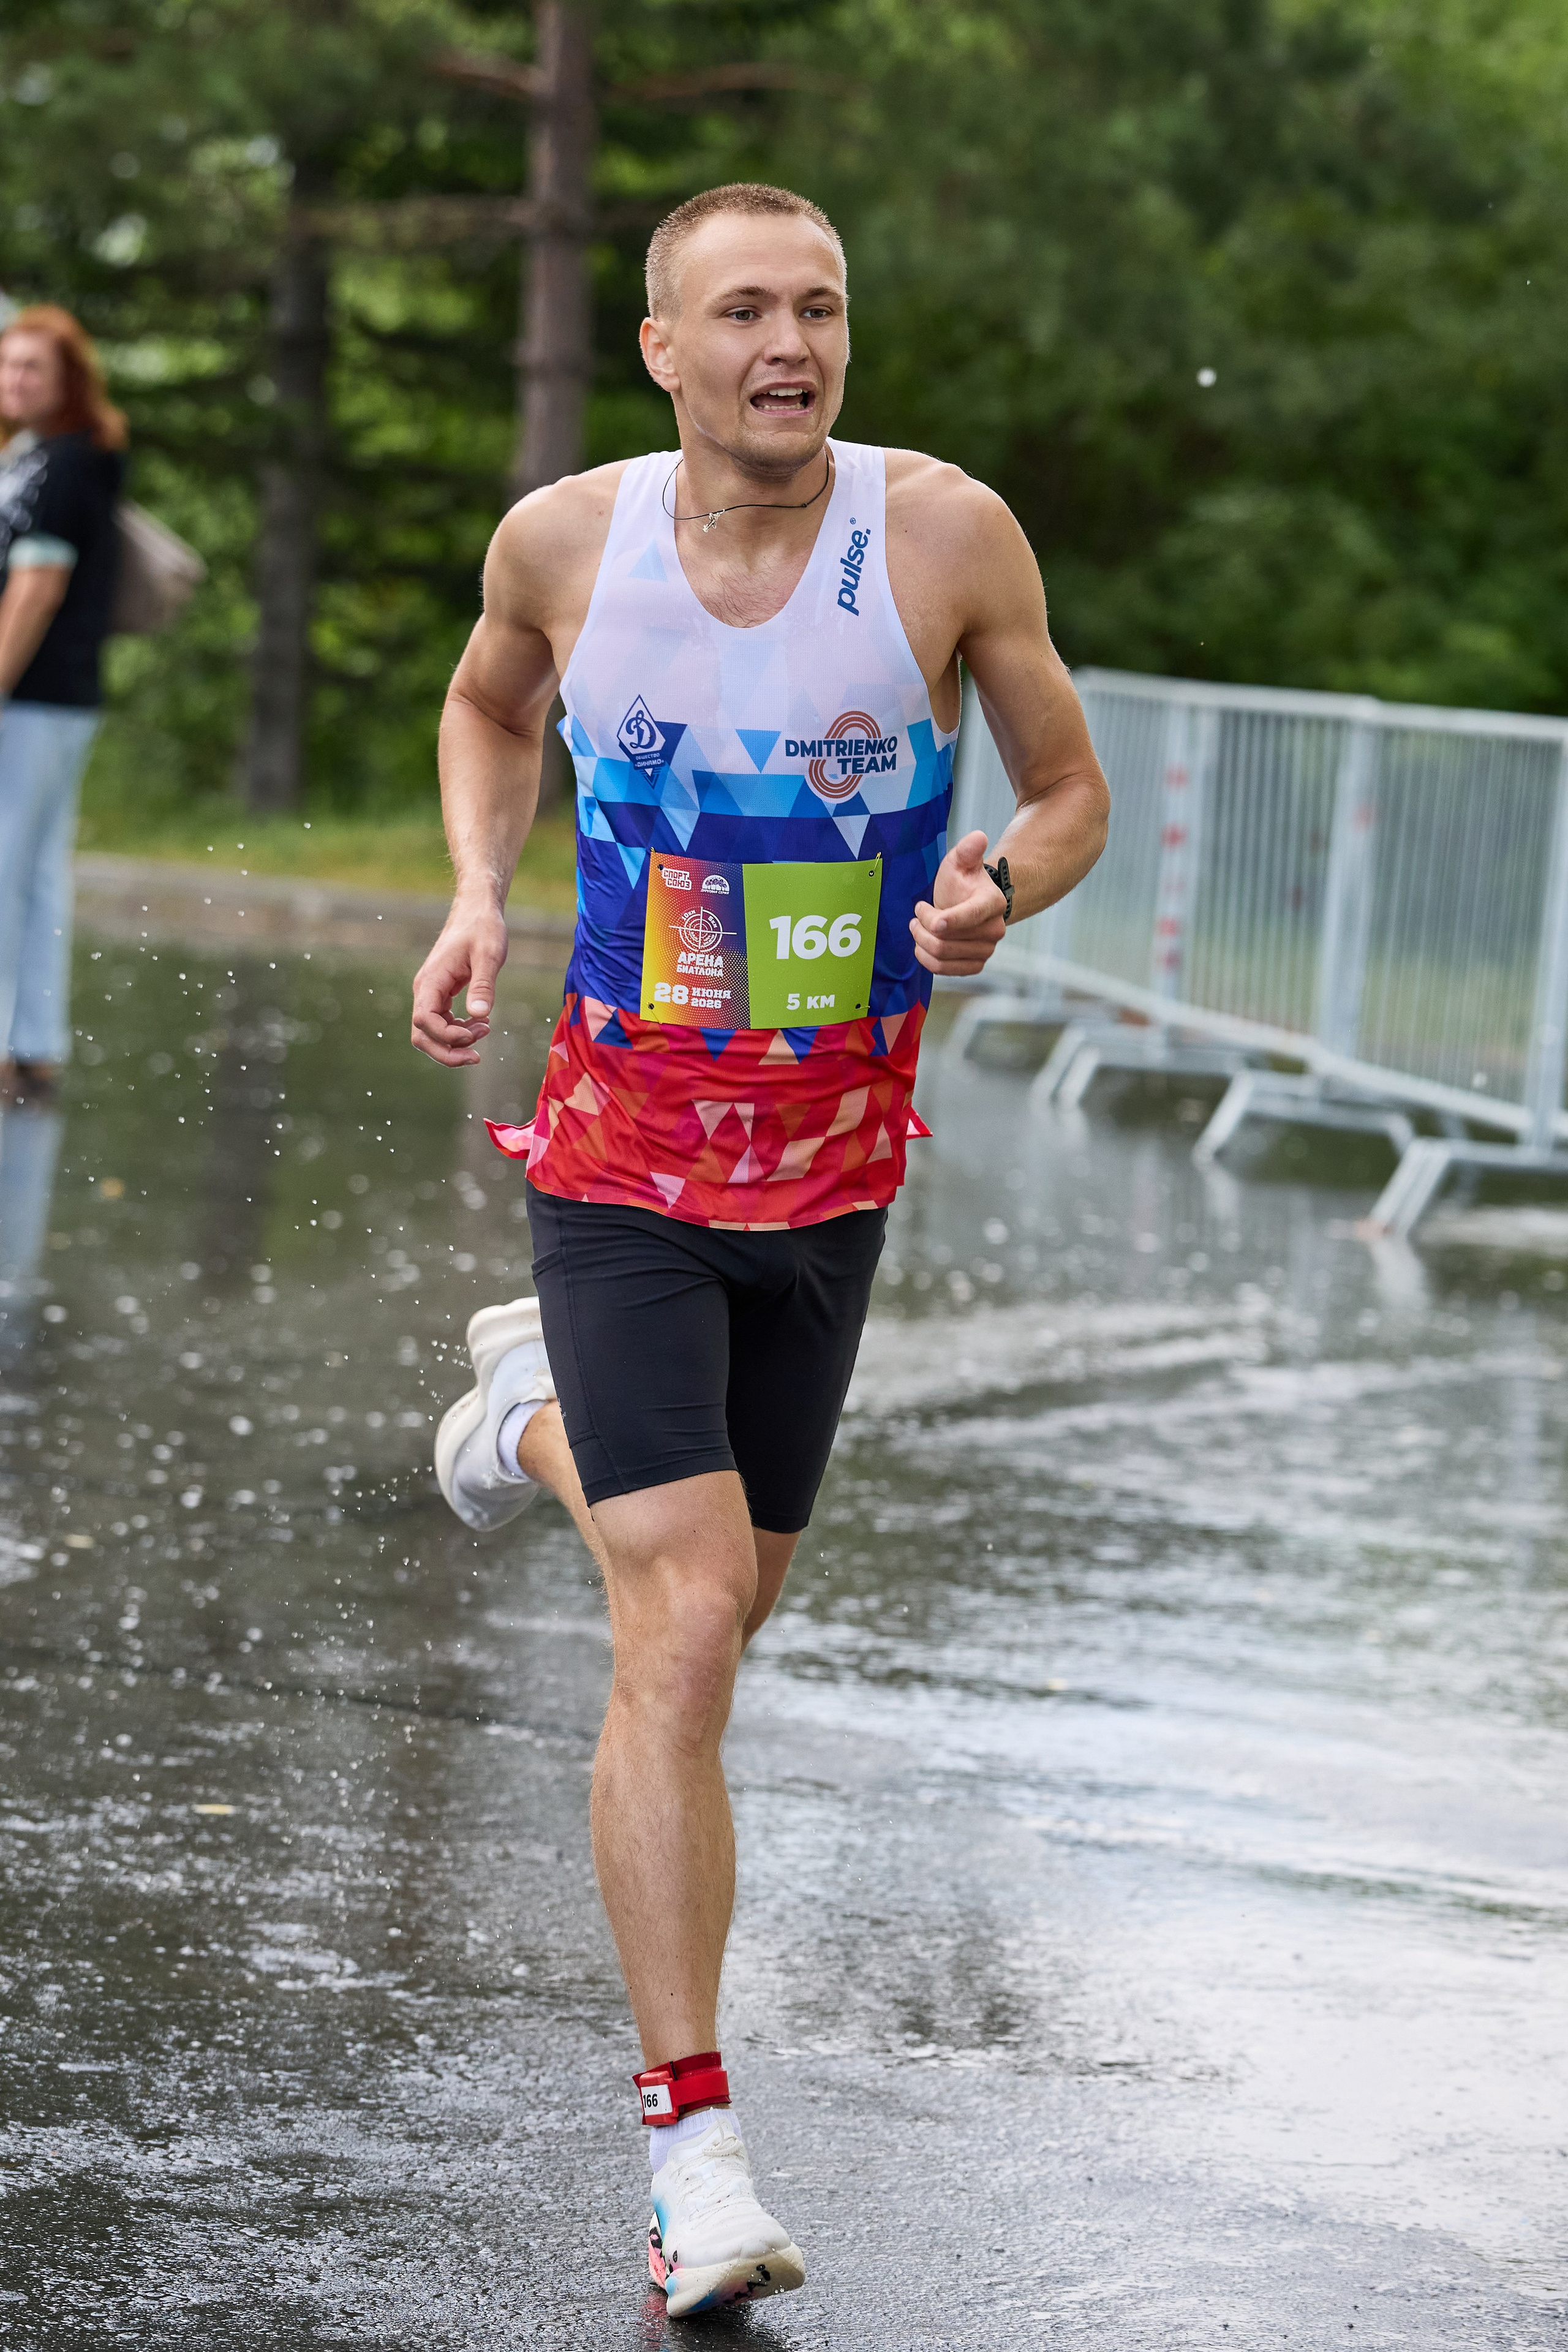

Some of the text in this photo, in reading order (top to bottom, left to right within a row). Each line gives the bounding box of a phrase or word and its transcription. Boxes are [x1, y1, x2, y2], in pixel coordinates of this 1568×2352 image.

[785, 736, 898, 758] DMITRIENKO
[837, 753, 897, 775] TEAM
[667, 878, 690, 889] СОЮЗ
[769, 913, 862, 960] 166
[677, 951, 724, 968] АРЕНА
[676, 964, 723, 977] БИАТЛОНА
[654, 982, 689, 1005] 28
[786, 993, 801, 1011] 5
[691, 998, 722, 1009] 2026
[643, 2093, 658, 2108] 166
